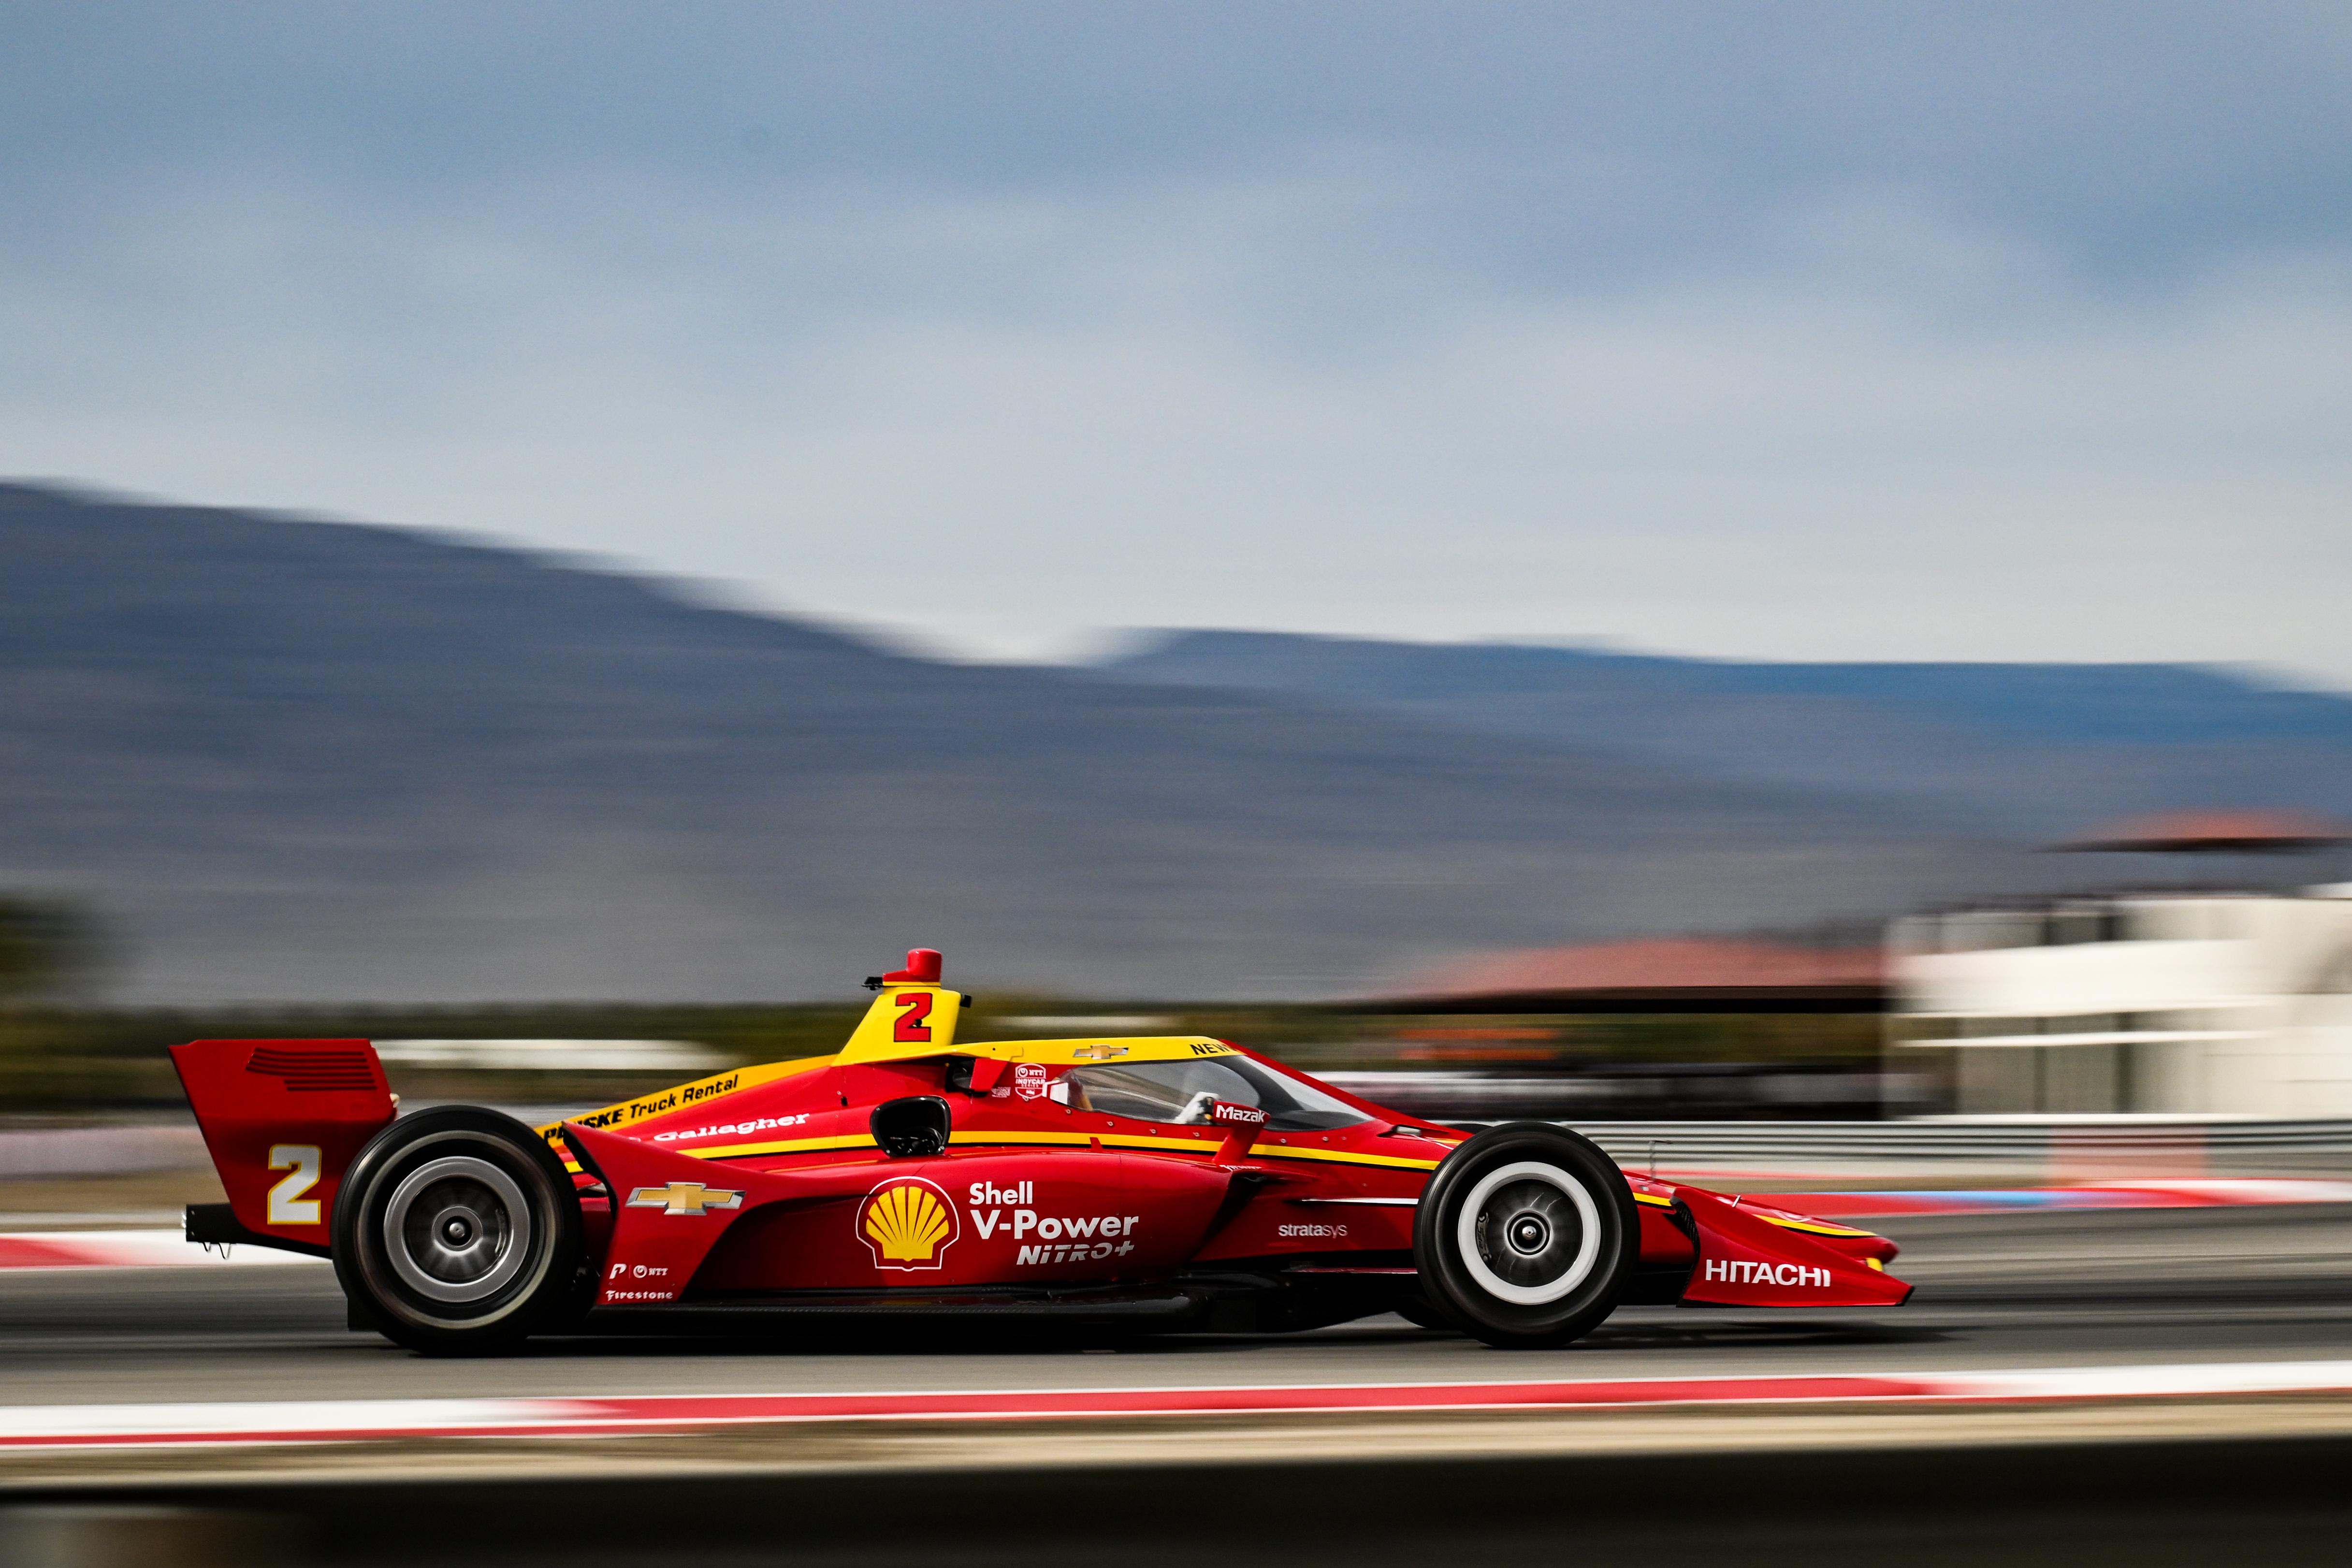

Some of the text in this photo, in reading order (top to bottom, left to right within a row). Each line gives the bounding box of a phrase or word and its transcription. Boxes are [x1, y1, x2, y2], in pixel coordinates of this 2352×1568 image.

[894, 992, 933, 1042] 2
[1190, 1044, 1236, 1055] NEW
[544, 1074, 738, 1140] PESKE Truck Rental
[1216, 1104, 1265, 1122] Mazak
[653, 1113, 810, 1142] Gallagher
[267, 1144, 322, 1225] 2
[969, 1181, 1033, 1205] Shell
[970, 1209, 1139, 1239] V-Power
[1278, 1223, 1349, 1239] stratasys
[1705, 1259, 1831, 1287] HITACHI
[606, 1290, 673, 1301] Firestone
